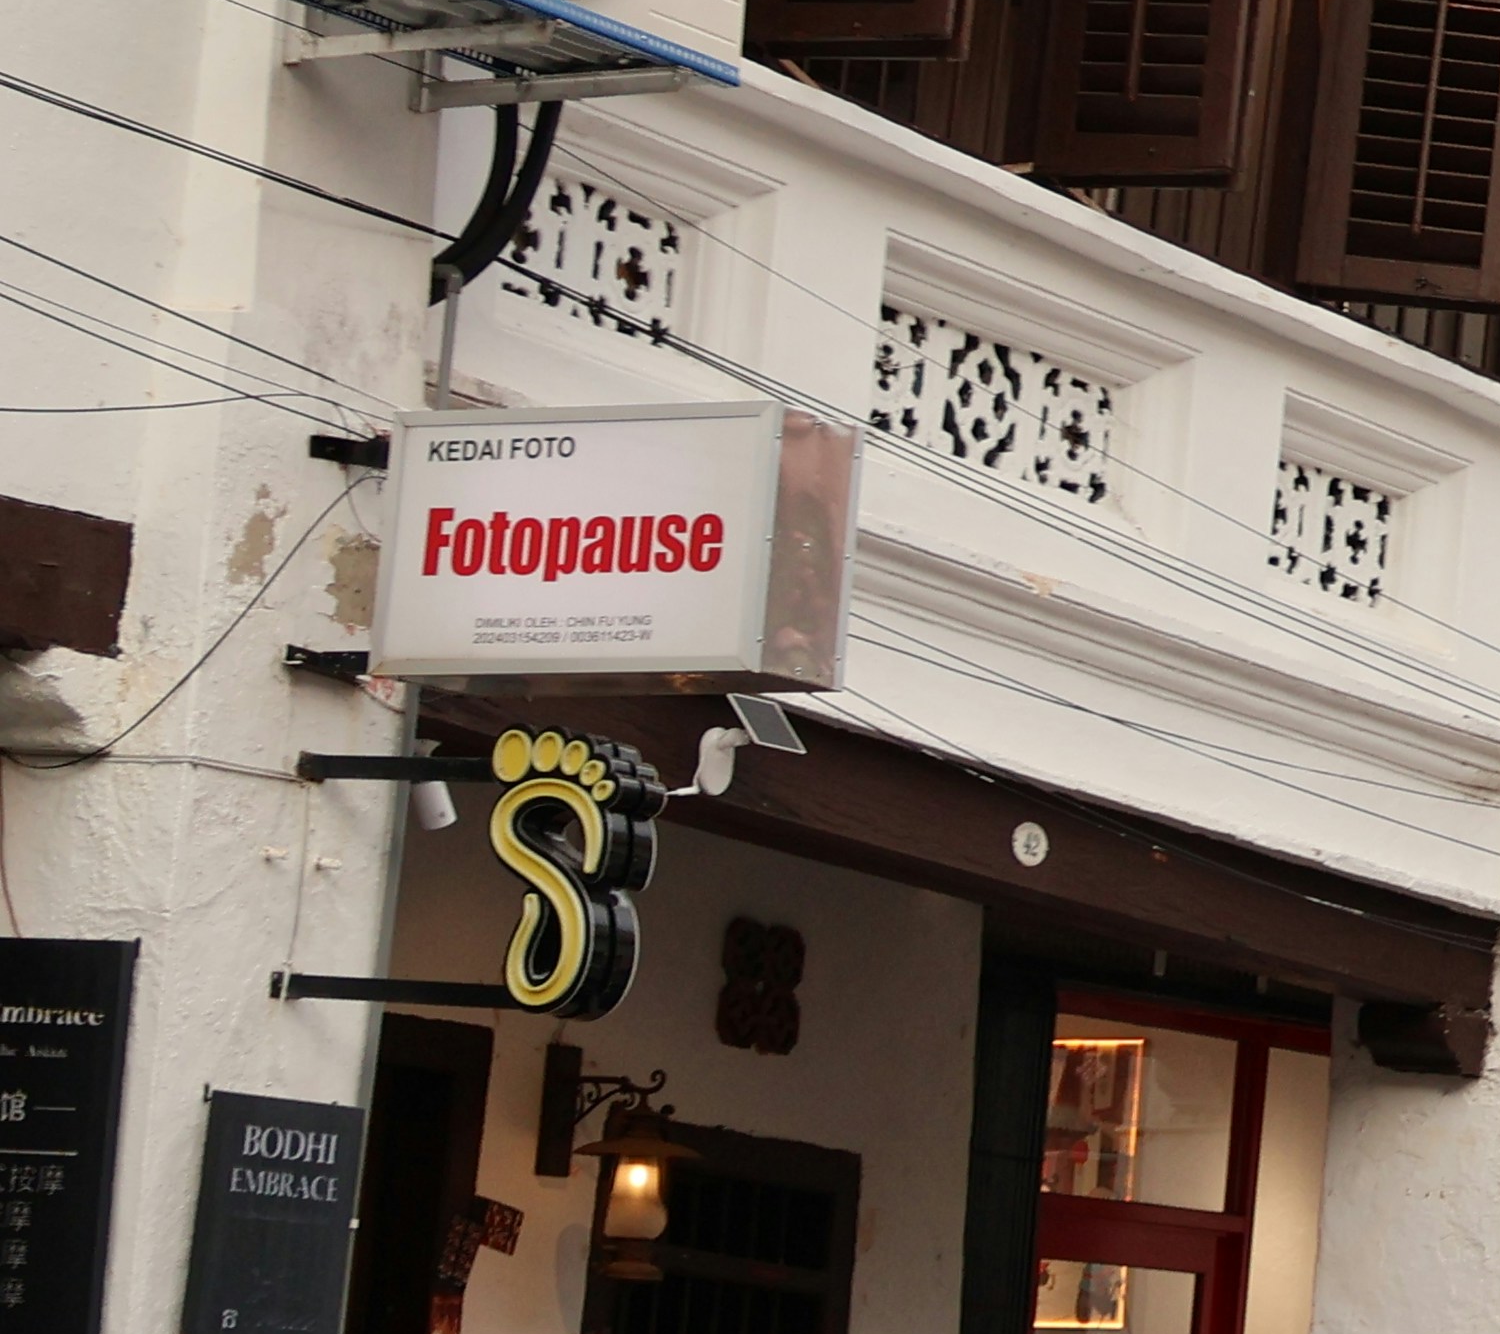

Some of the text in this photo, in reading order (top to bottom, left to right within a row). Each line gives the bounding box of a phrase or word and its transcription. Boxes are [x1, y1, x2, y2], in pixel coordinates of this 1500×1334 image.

[428, 436, 576, 462] KEDAI FOTO
[421, 507, 725, 582] Fotopause
[523, 617, 556, 628] OLEH
[566, 616, 595, 628] CHIN
[617, 615, 652, 626] YUNG
[0, 1004, 105, 1027] mbrace
[242, 1124, 338, 1165] BODHI
[229, 1167, 338, 1202] EMBRACE
